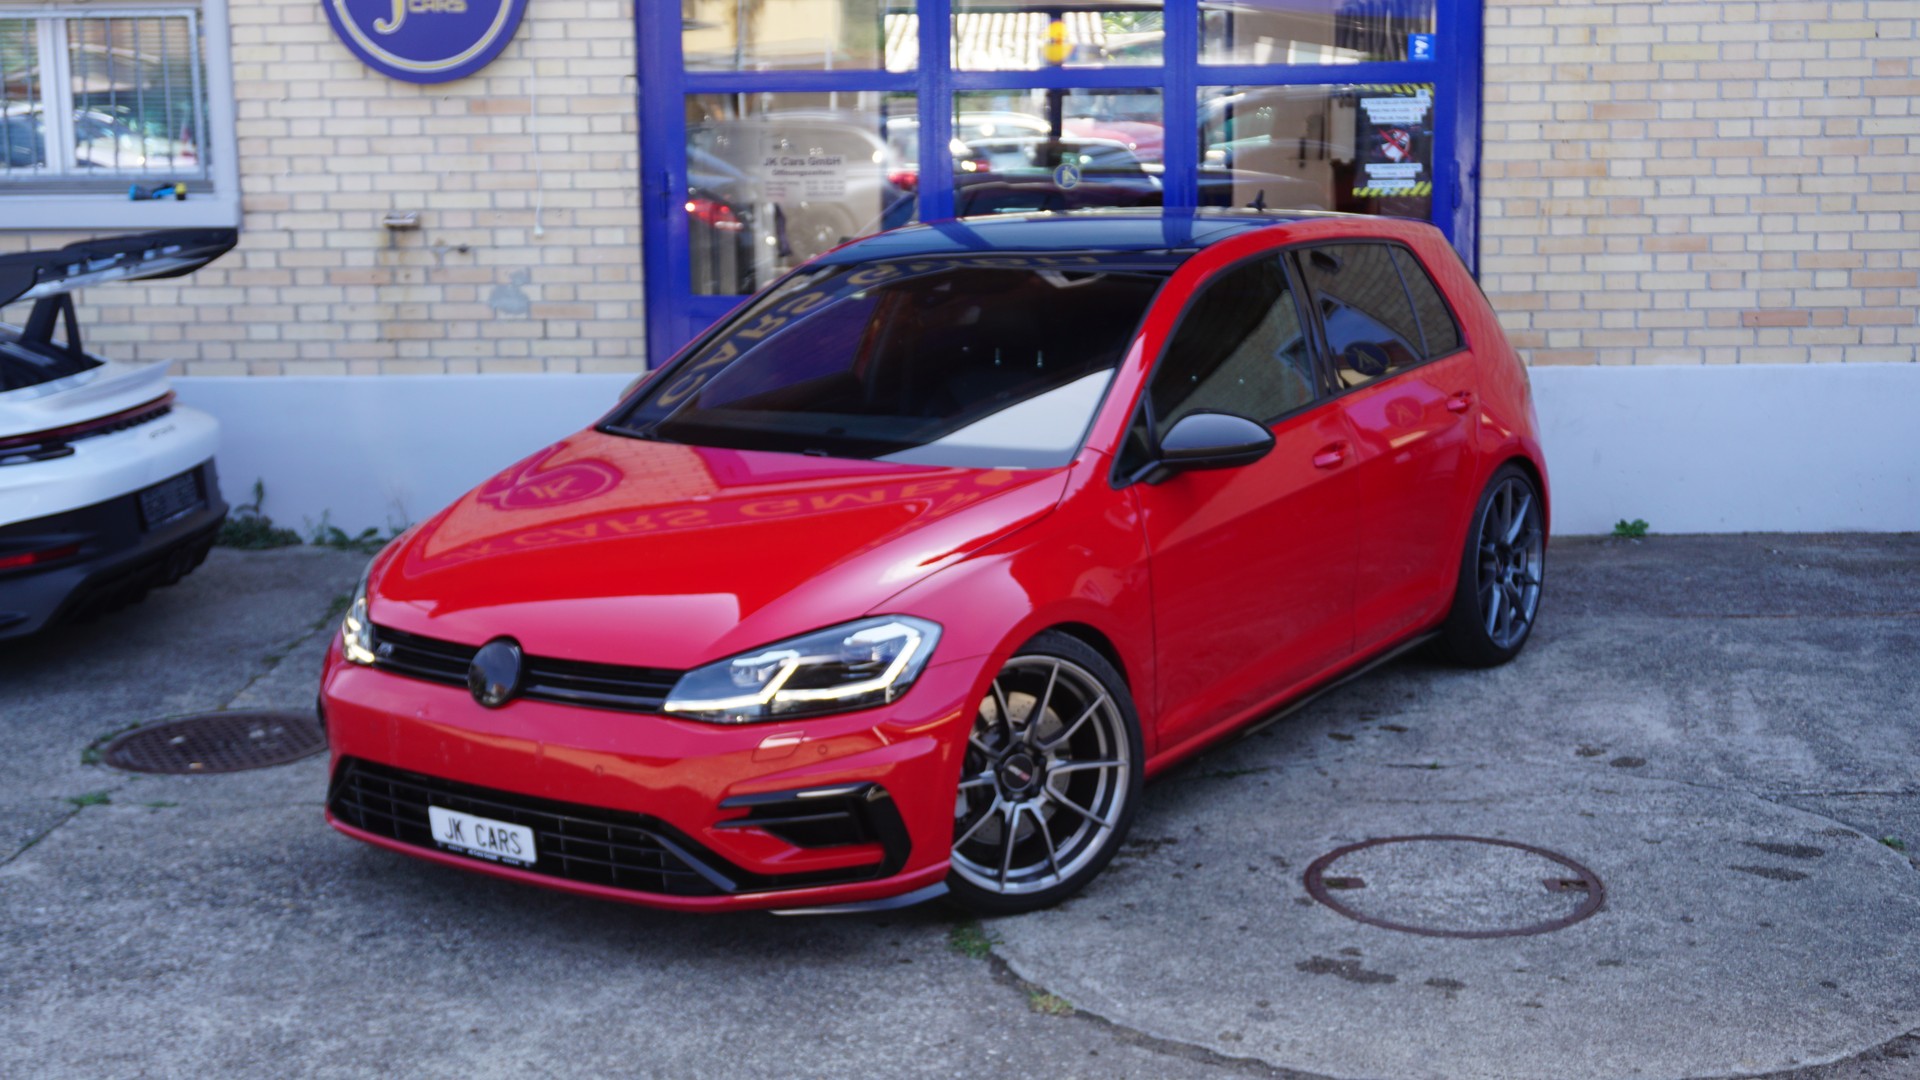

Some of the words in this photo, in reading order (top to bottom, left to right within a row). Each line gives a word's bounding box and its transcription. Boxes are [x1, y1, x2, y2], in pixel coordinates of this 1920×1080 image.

[781, 157, 805, 166] Cars
[808, 156, 842, 166] GmbH
[445, 817, 464, 842] JK
[475, 823, 522, 855] CARS
